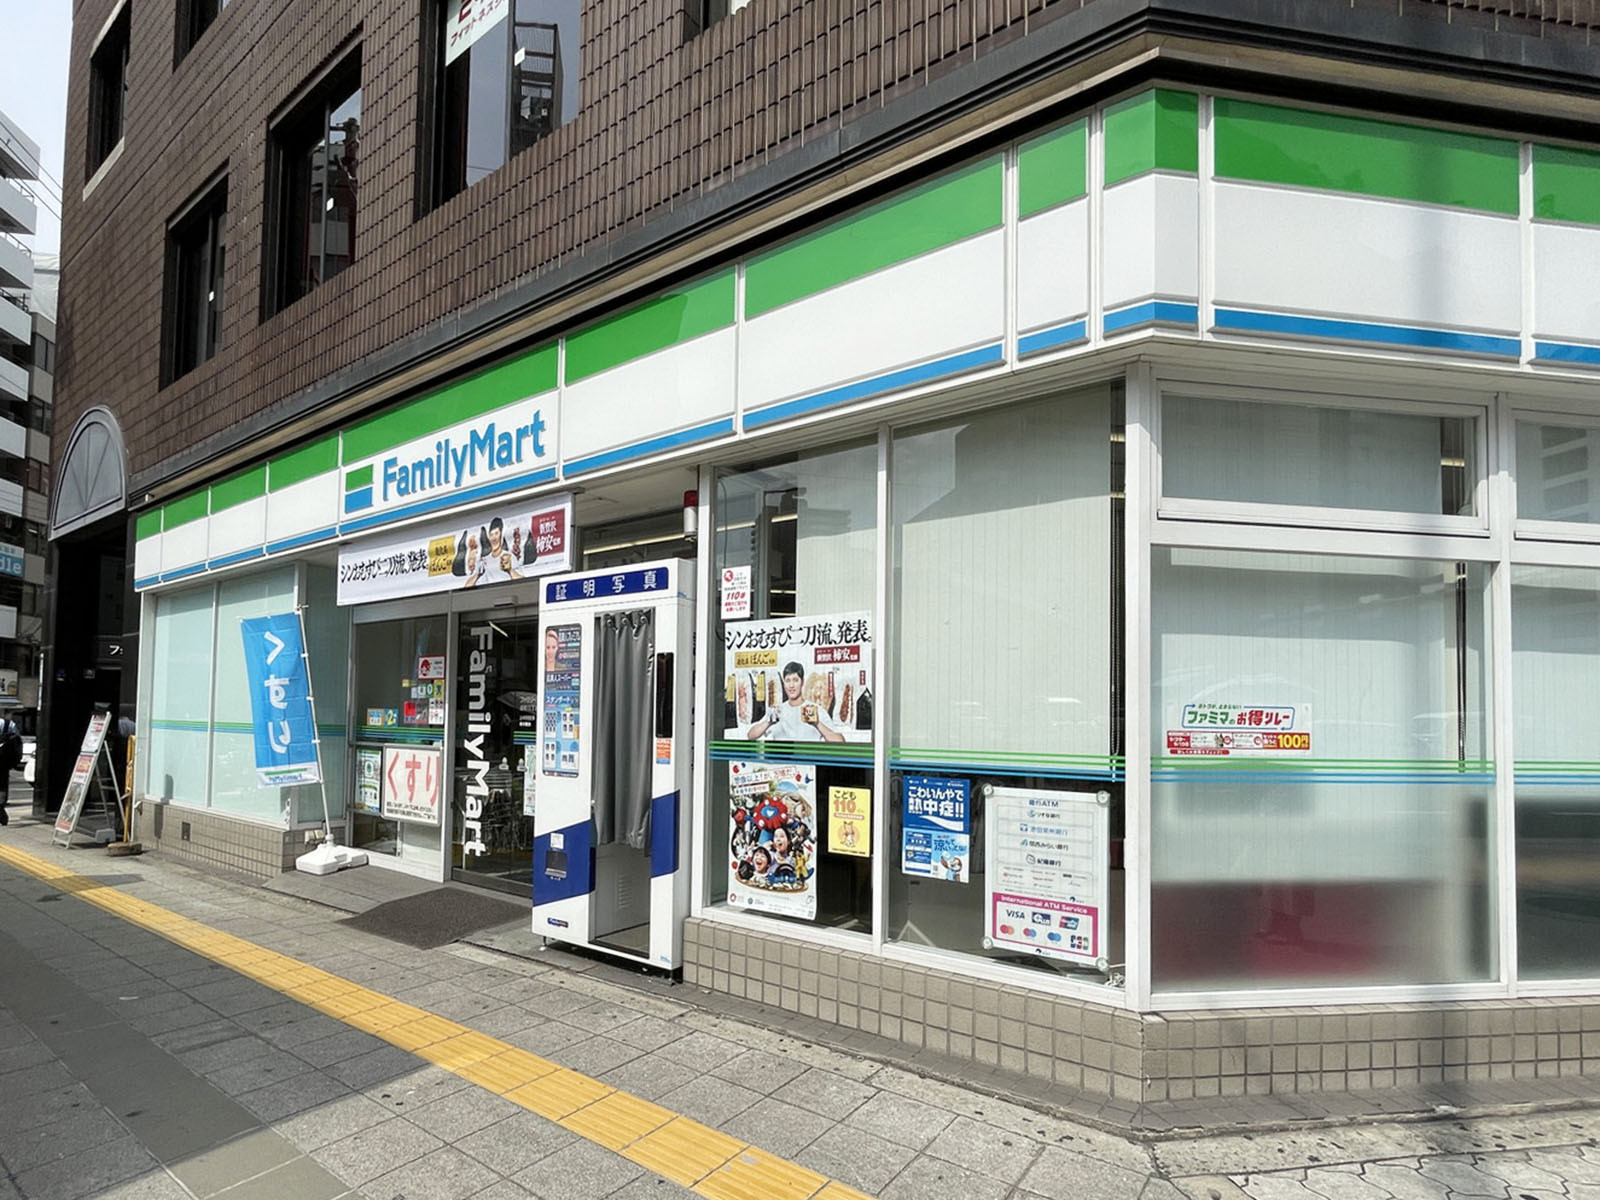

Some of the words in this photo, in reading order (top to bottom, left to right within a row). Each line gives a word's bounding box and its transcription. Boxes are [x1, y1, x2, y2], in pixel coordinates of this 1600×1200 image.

[382, 409, 546, 501] FamilyMart
[555, 570, 657, 600] 証明写真
[726, 620, 872, 650] シンおむすび二刀流、発表。
[263, 630, 291, 754] くすり
[1187, 709, 1291, 727] ファミマのお得リレー
[464, 626, 493, 857] FamilyMart
[387, 750, 441, 807] くすり
[833, 789, 857, 801] こども
[908, 785, 964, 802] こわいんやで
[833, 799, 857, 813] 110
[1000, 895, 1043, 908] International
[1043, 901, 1060, 910] ATM
[1061, 904, 1088, 914] Service
[1006, 908, 1026, 920] VISA
